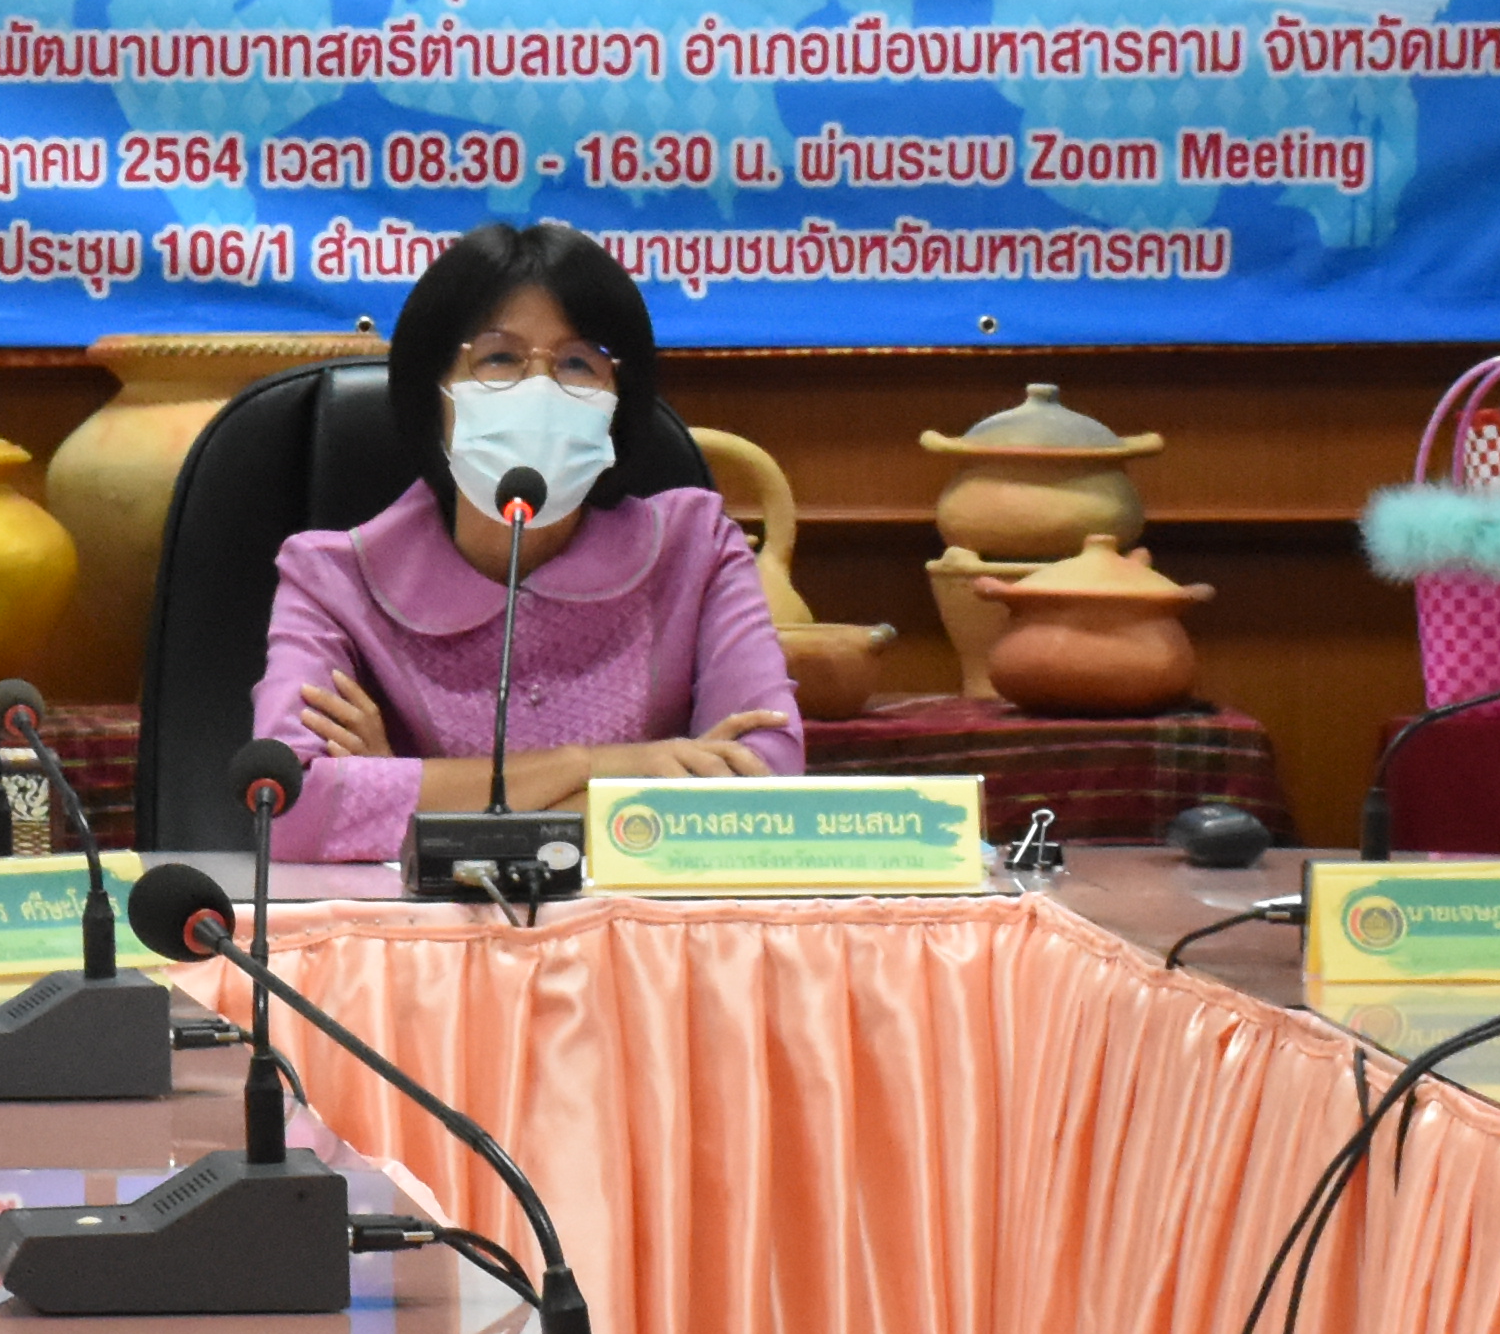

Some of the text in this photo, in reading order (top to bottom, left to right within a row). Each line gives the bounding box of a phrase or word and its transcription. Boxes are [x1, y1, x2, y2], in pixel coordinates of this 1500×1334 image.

[686, 17, 1243, 78] อำเภอเมืองมหาสารคาม
[124, 136, 244, 186] 2564
[266, 142, 368, 185] เวลา
[389, 135, 522, 186] 08.30
[585, 136, 714, 185] 16.30
[734, 144, 779, 185] น.
[800, 132, 1009, 185] ผ่านระบบ
[1030, 133, 1159, 183] Zoom
[1182, 132, 1368, 191] Meeting
[161, 229, 290, 279] 106/1
[664, 809, 923, 836] นางสงวน มะเสนา
